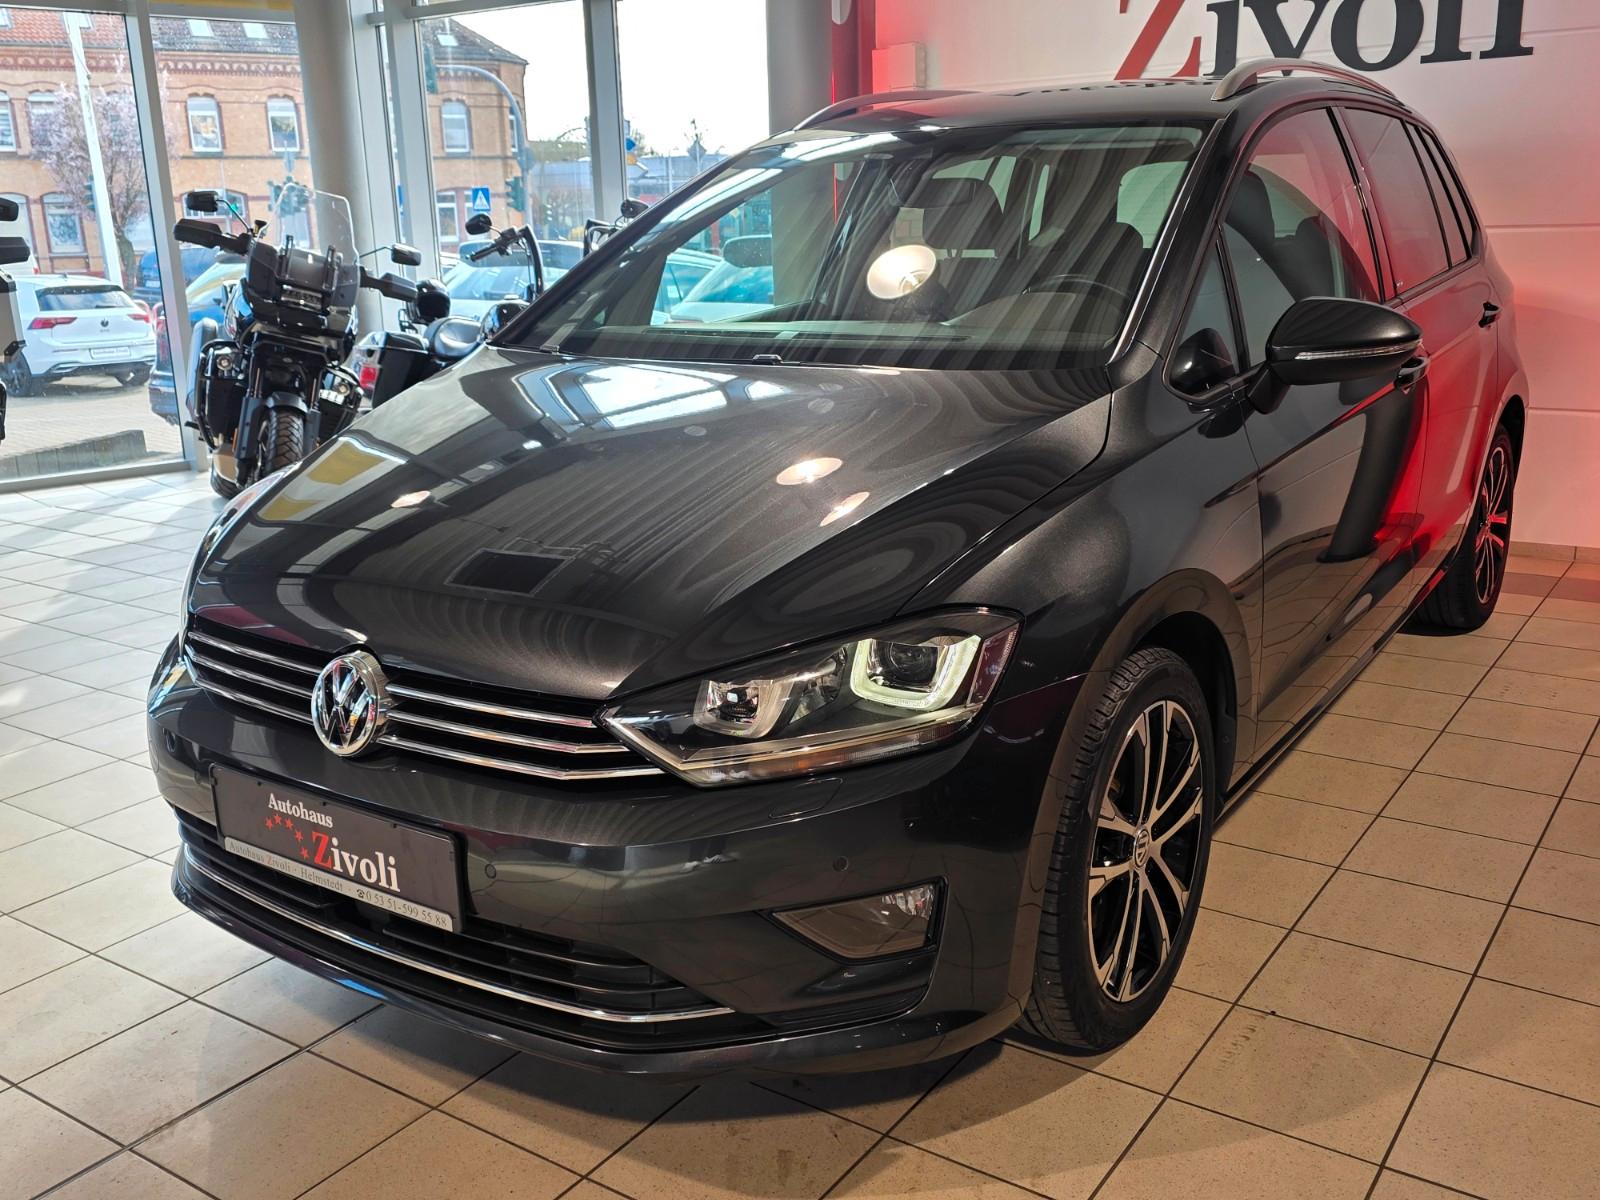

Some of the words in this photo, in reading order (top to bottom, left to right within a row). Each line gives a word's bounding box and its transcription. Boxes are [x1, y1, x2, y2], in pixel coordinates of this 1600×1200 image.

[268, 793, 333, 828] Autohaus
[229, 841, 264, 862] Autohaus
[265, 855, 290, 872] Zivoli
[300, 868, 343, 892] Helmstedt
[374, 893, 385, 905] 53
[421, 910, 432, 922] 55
[435, 914, 448, 928] 88
[312, 831, 400, 892] Zivoli
